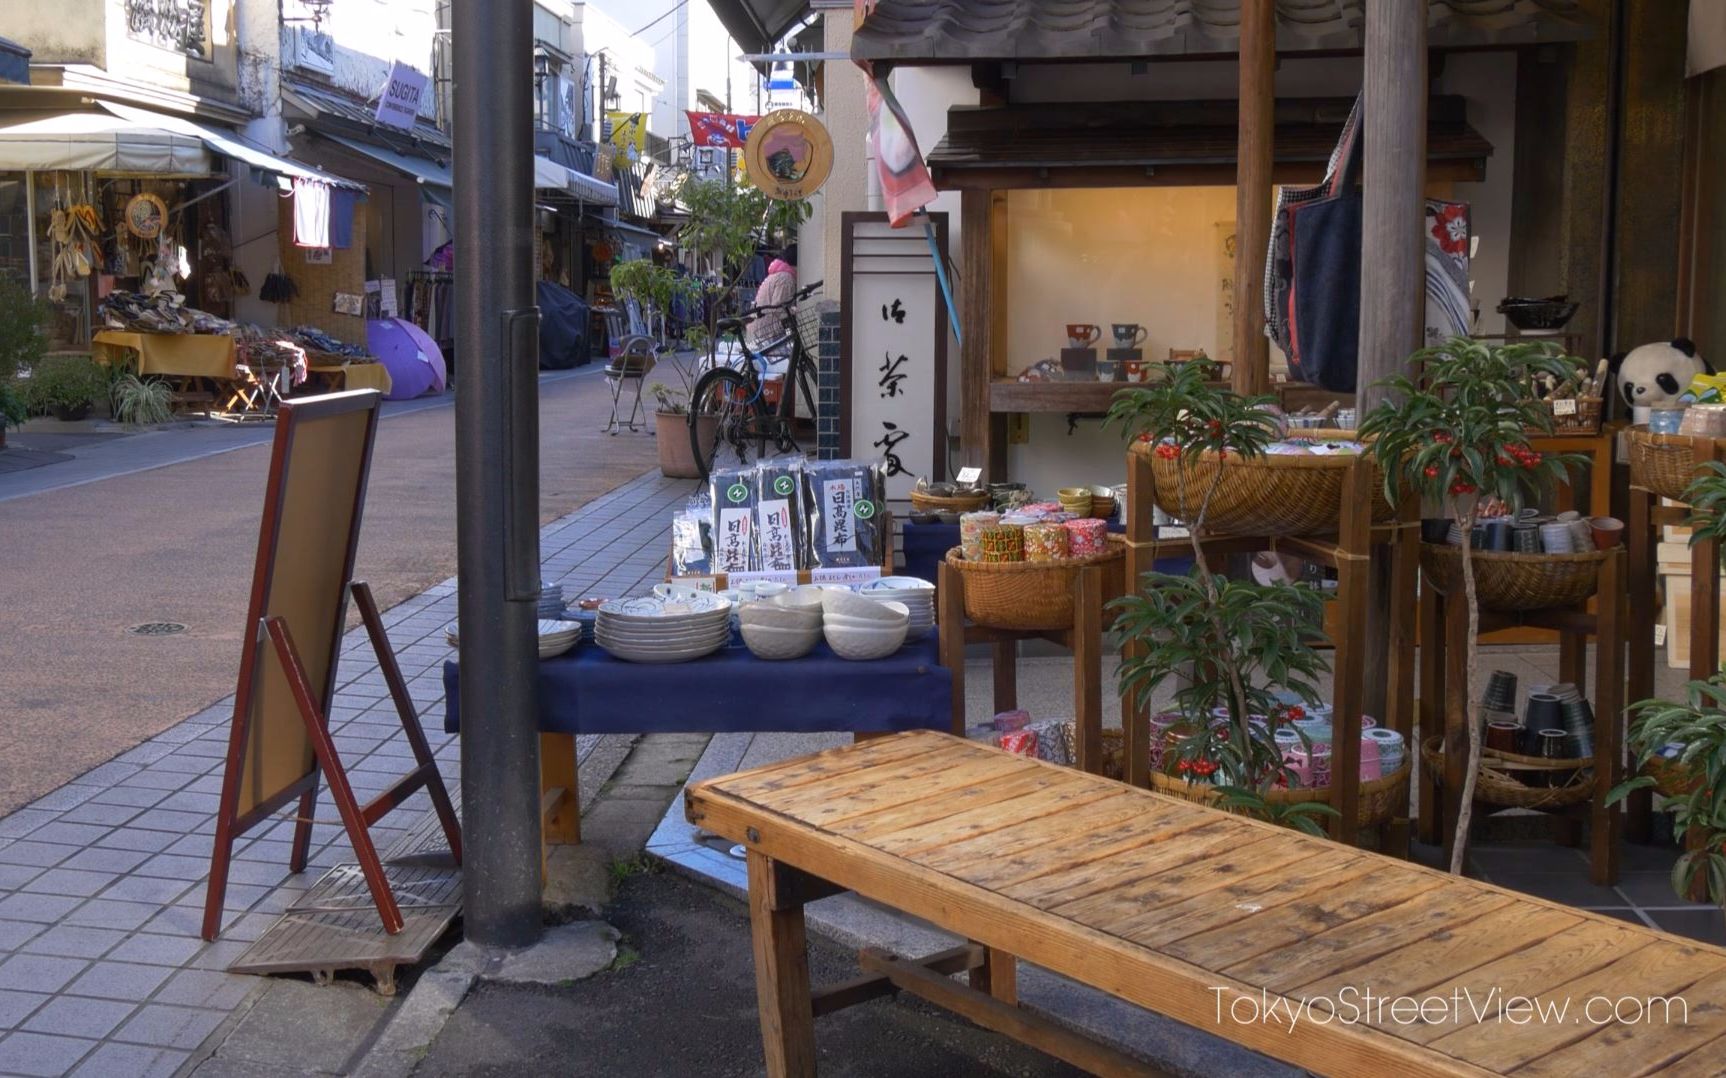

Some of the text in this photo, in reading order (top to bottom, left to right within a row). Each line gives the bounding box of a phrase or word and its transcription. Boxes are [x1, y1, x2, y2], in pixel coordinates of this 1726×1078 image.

[389, 80, 420, 104] SUGITA
[832, 491, 848, 549] 日高昆布
